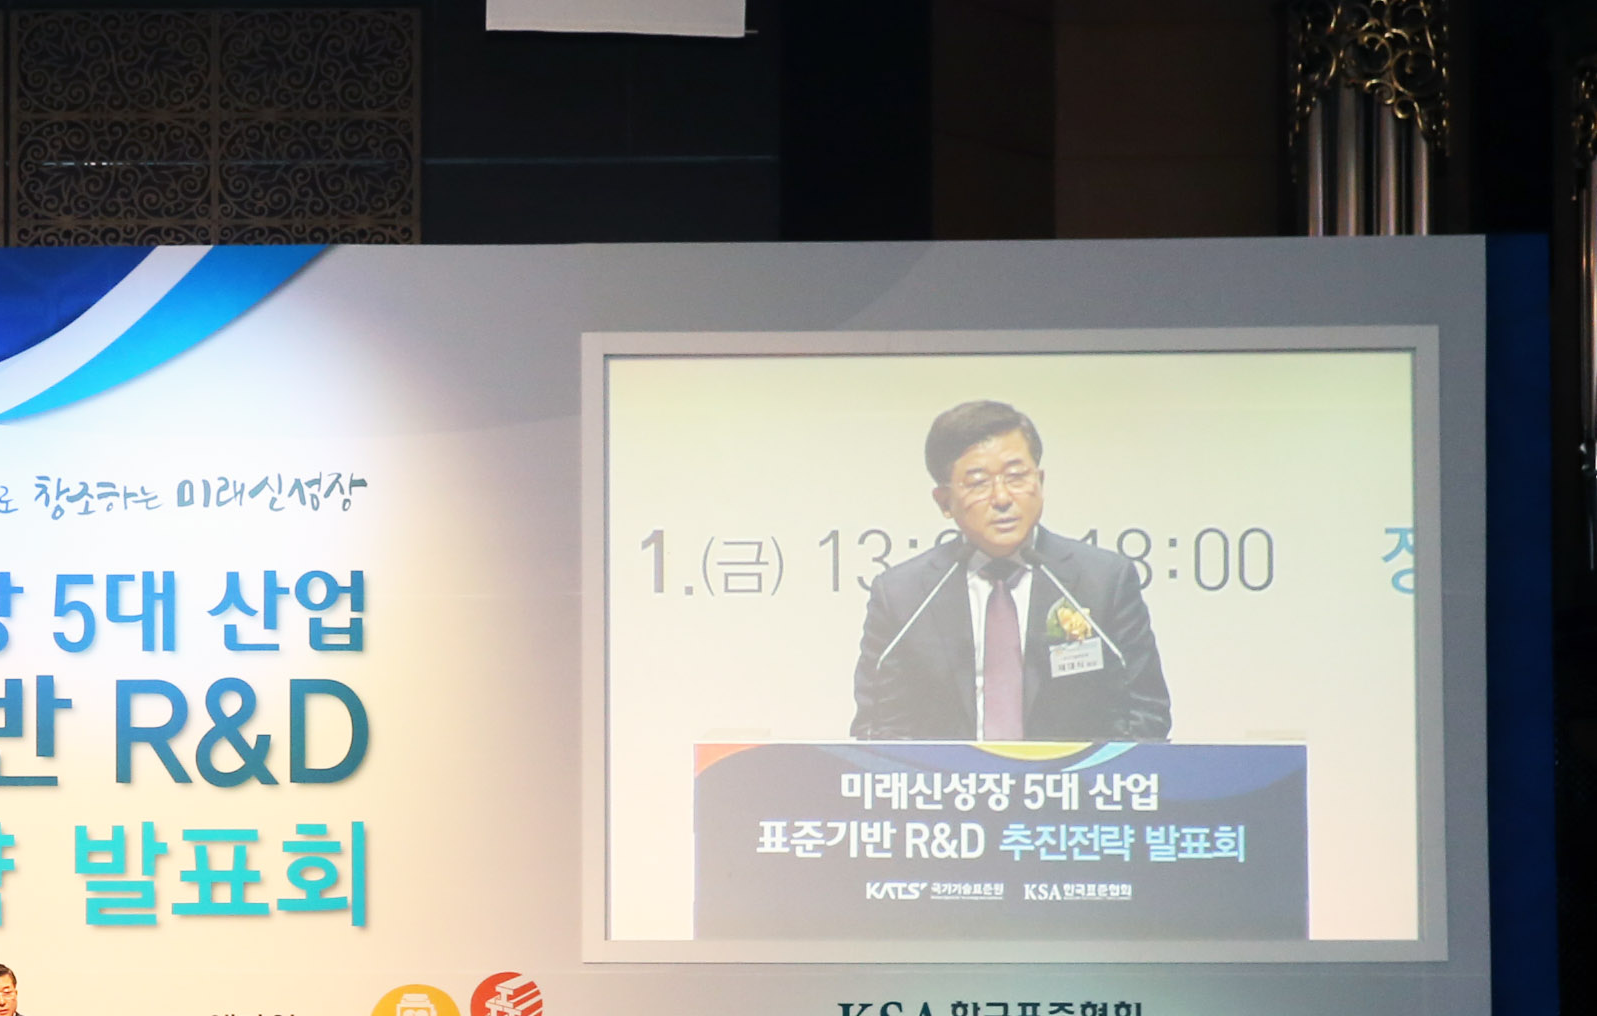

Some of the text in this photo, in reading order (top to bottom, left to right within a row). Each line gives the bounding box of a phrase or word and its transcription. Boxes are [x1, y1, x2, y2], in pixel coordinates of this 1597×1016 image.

[34, 475, 162, 520] 창조하는
[177, 471, 368, 511] 미래신성장
[53, 570, 177, 653] 5대
[207, 570, 366, 652] 산업
[116, 677, 369, 788] R&D
[841, 772, 1159, 811] 미래신성장 5대 산업
[757, 820, 1246, 863] 표준기반 R&D 추진전략 발표회
[73, 821, 365, 927] 발표회
[866, 883, 922, 899] KATS
[1024, 884, 1061, 900] KSA
